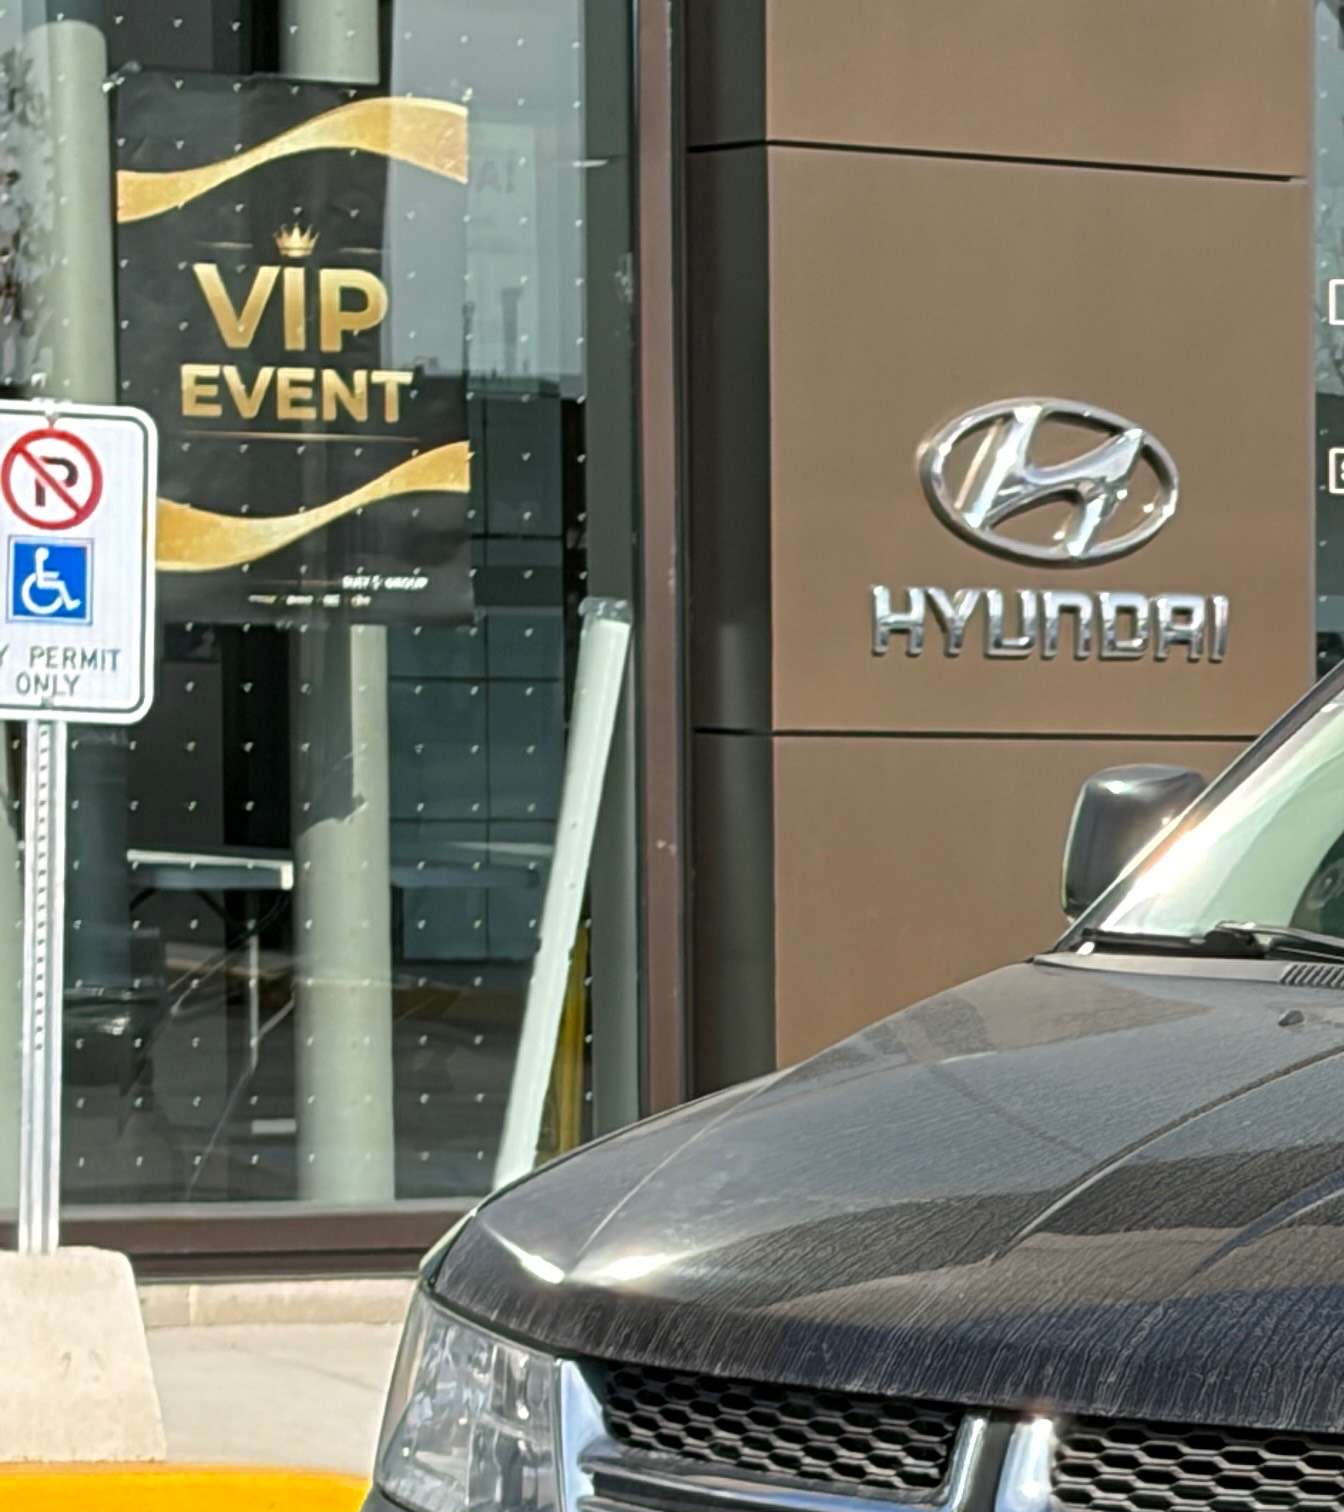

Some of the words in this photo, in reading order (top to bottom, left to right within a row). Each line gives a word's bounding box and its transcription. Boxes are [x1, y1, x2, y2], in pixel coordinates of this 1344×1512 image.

[194, 262, 389, 353] VIP
[180, 363, 414, 424] EVENT
[870, 583, 1230, 663] HYUNDAI
[16, 671, 80, 697] ONLY
[29, 645, 122, 673] PERMIT
